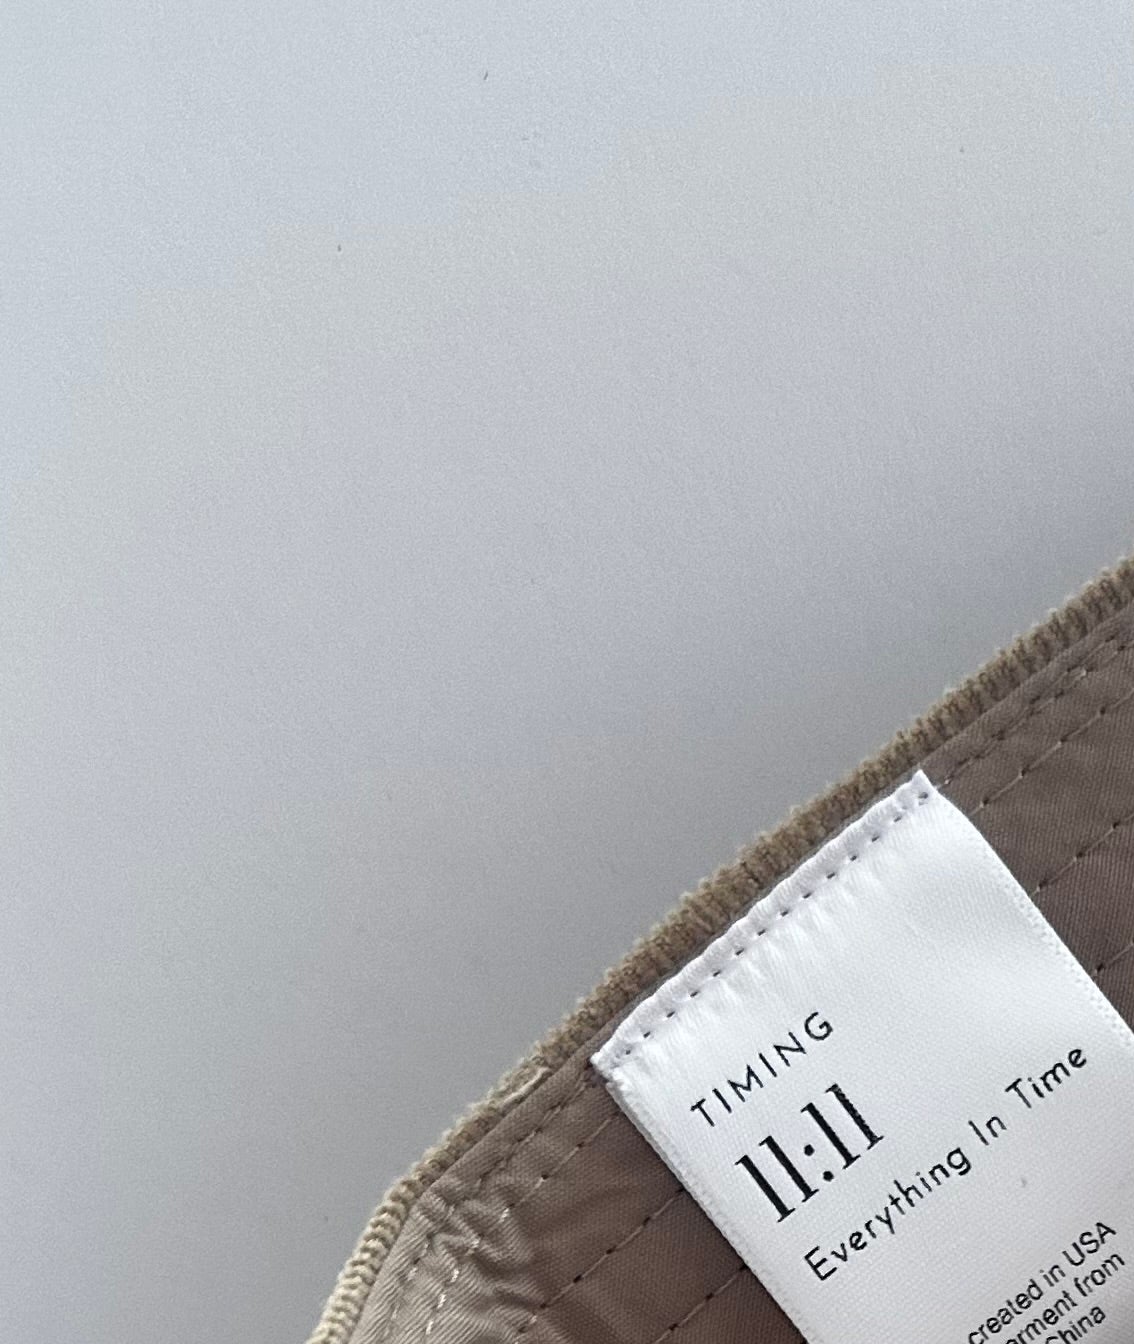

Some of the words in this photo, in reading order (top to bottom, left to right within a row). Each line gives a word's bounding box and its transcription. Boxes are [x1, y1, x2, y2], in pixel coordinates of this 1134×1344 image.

[689, 1011, 834, 1128] TIMING
[734, 1082, 885, 1224] 11:11
[803, 1146, 973, 1282] Everything
[968, 1113, 1008, 1147] In
[1004, 1048, 1088, 1109] Time
[1040, 1263, 1067, 1289] in
[1062, 1221, 1117, 1267] USA
[1074, 1253, 1126, 1298] from
